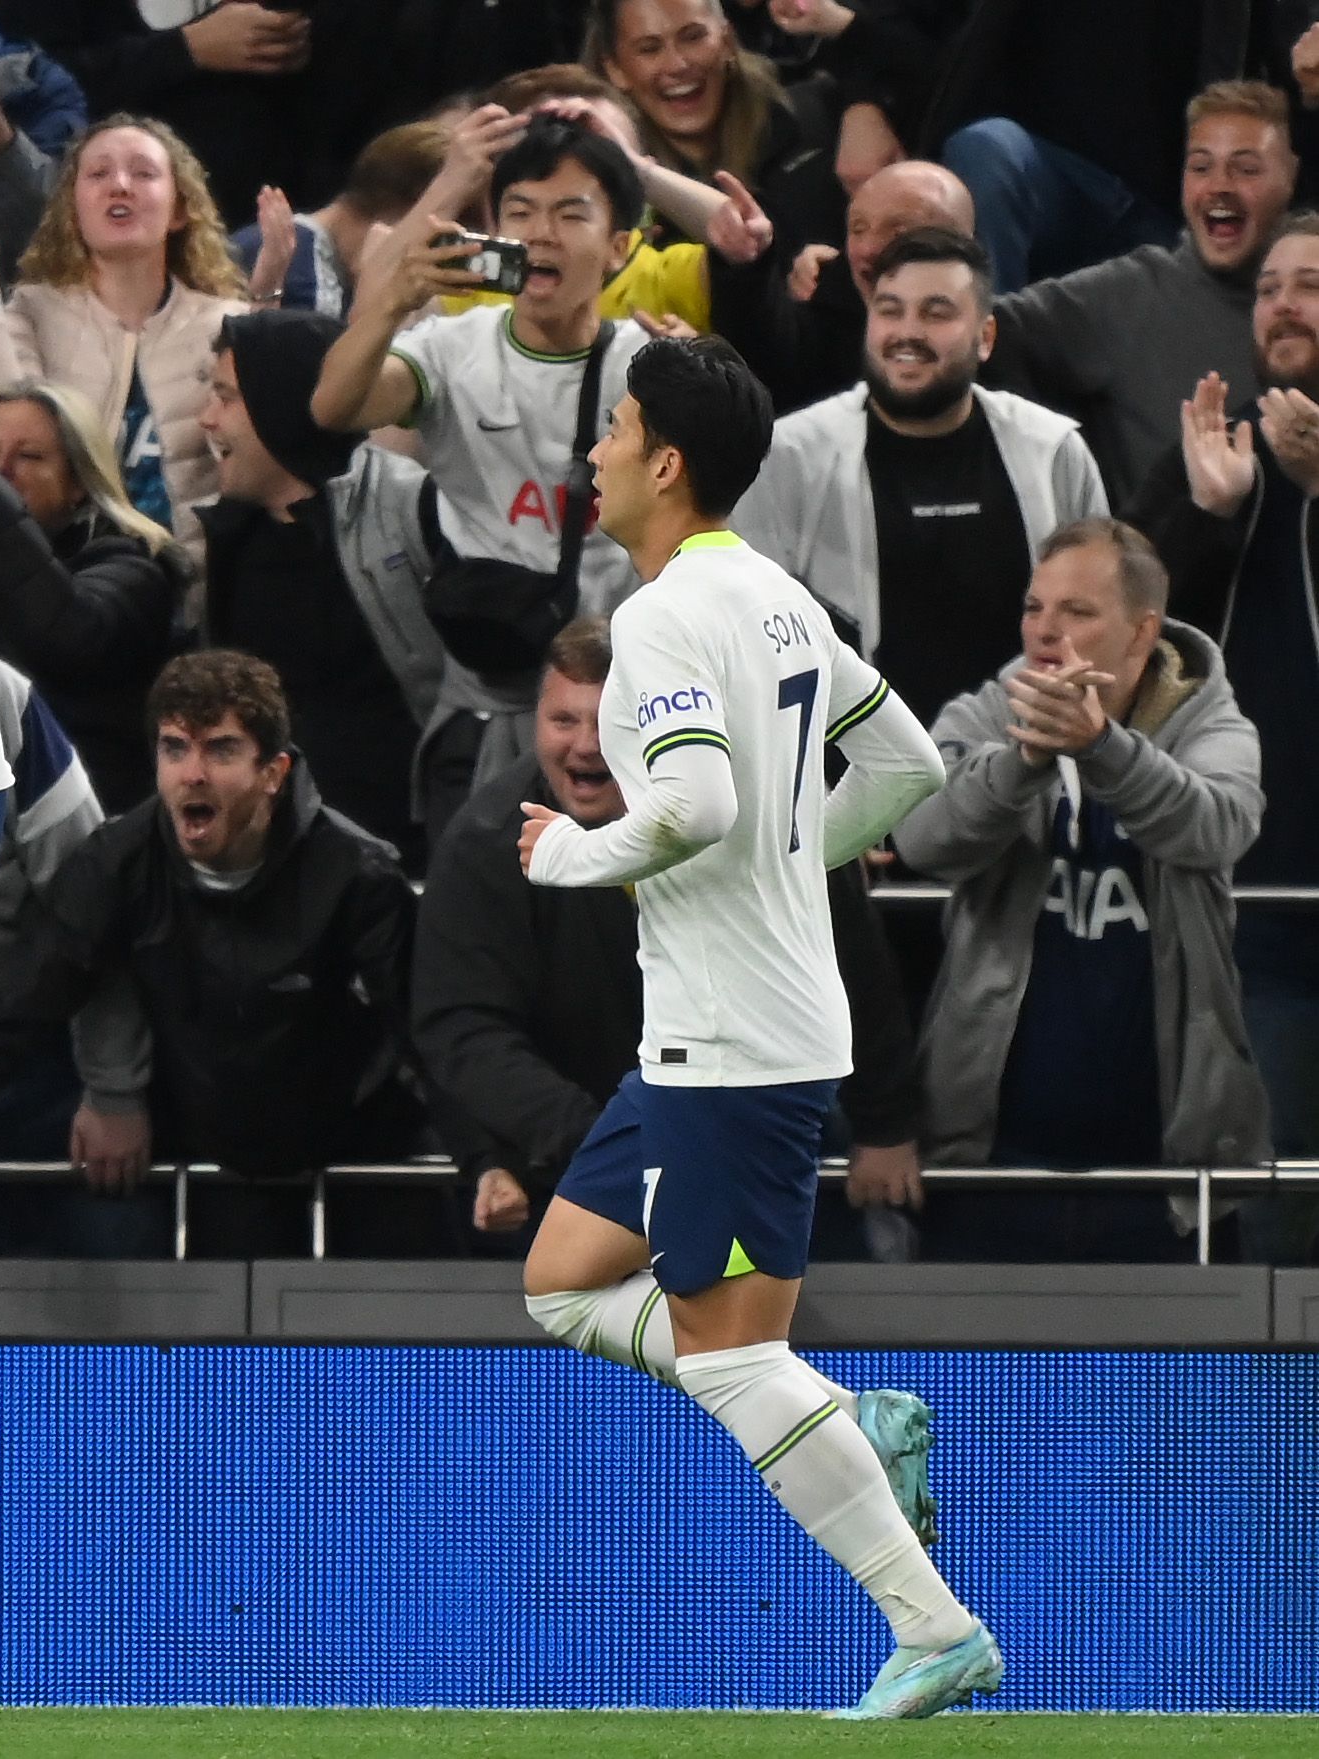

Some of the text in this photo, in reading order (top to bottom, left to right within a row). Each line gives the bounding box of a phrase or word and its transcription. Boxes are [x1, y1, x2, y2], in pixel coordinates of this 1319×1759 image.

[507, 478, 600, 537] AI
[763, 611, 812, 654] SON
[638, 686, 714, 729] cinch
[778, 667, 820, 855] 7
